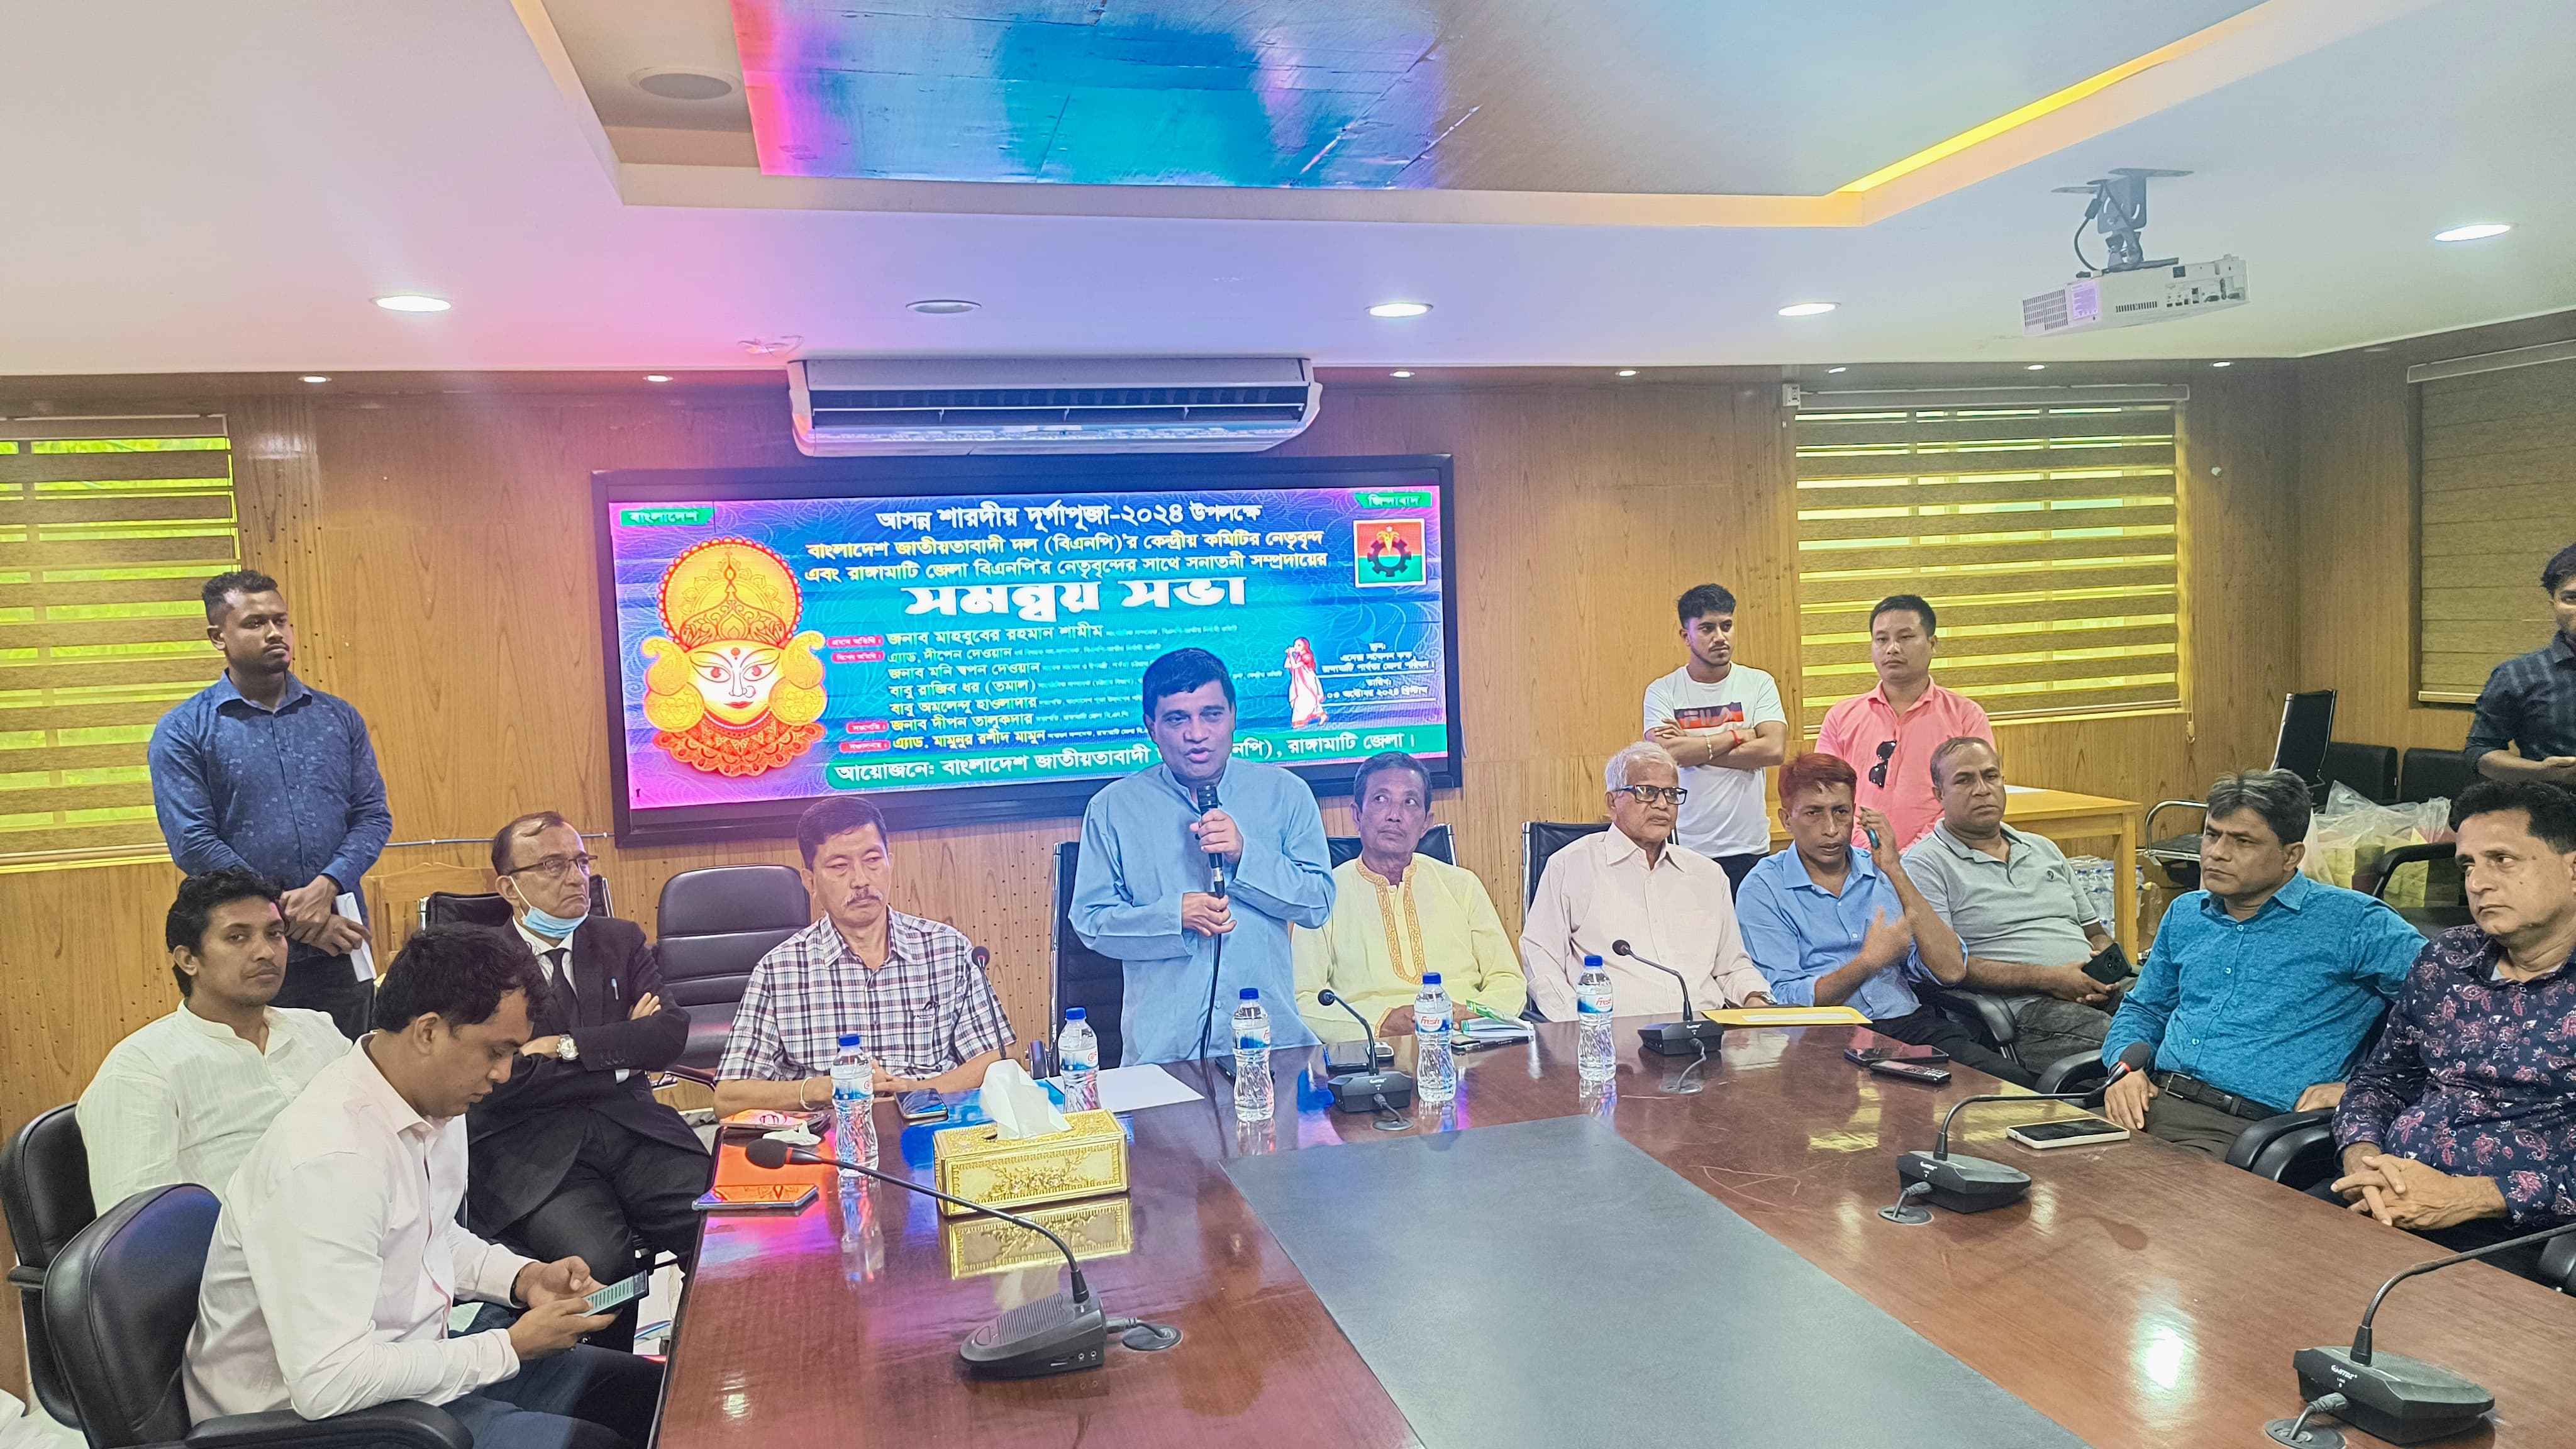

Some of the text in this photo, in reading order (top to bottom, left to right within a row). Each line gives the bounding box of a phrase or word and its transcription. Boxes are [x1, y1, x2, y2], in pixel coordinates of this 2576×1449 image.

[629, 511, 699, 523] বাংলাদেশ
[875, 511, 932, 532] আসন্ন
[937, 500, 1019, 528] শারদীয়
[1188, 500, 1262, 522] উপলক্ষে
[806, 540, 889, 560] বাংলাদেশ
[894, 534, 1006, 557] জাতীয়তাবাদী
[1009, 537, 1039, 553] দল
[1143, 530, 1198, 550] কেন্দ্রীয়
[1202, 529, 1260, 547] কমিটির
[1265, 530, 1324, 551] নেতৃবৃন্দ
[805, 567, 841, 583] এবং
[845, 562, 921, 581] রাঙ্গামাটি
[925, 563, 969, 580] জেলা
[1057, 558, 1138, 580] নেতৃবৃন্দের
[1140, 555, 1180, 573] সাথে
[1184, 550, 1246, 570] সনাতনী
[1249, 552, 1328, 570] সম্প্রদায়ের
[901, 576, 1248, 623] সমন্বয় সভা
[886, 631, 930, 647] জনাব
[933, 630, 1001, 647] মাহবুবের
[1006, 627, 1055, 642] রহমান
[1059, 622, 1104, 640] শামীম
[923, 648, 963, 662] দীপেন
[966, 647, 1013, 660] দেওয়ান
[888, 667, 926, 680] জনাব
[928, 662, 955, 678] মনি
[955, 664, 988, 676] স্বপন
[991, 662, 1041, 675] দেওয়ান
[889, 684, 914, 699] বাবু
[918, 680, 957, 697] রাজিব
[962, 682, 980, 694] ধর
[984, 679, 1036, 696] (তমাল)
[889, 702, 915, 717] বাবু
[918, 699, 972, 715] অমলেন্দু
[976, 696, 1038, 711] হাওলাদার
[1684, 706, 1734, 728] FILA
[890, 718, 928, 732] জনাব
[930, 714, 967, 730] দীপন
[970, 713, 1035, 730] তালুকদার
[931, 733, 974, 750] মামুনুর
[977, 728, 1010, 744] রশীদ
[1014, 730, 1046, 745] মামুন
[1287, 731, 1360, 755] রাঙ্গামাটি
[1363, 733, 1405, 750] জেলা
[940, 755, 1030, 776] বাংলাদেশ
[1035, 745, 1151, 770] জাতীয়তাবাদী
